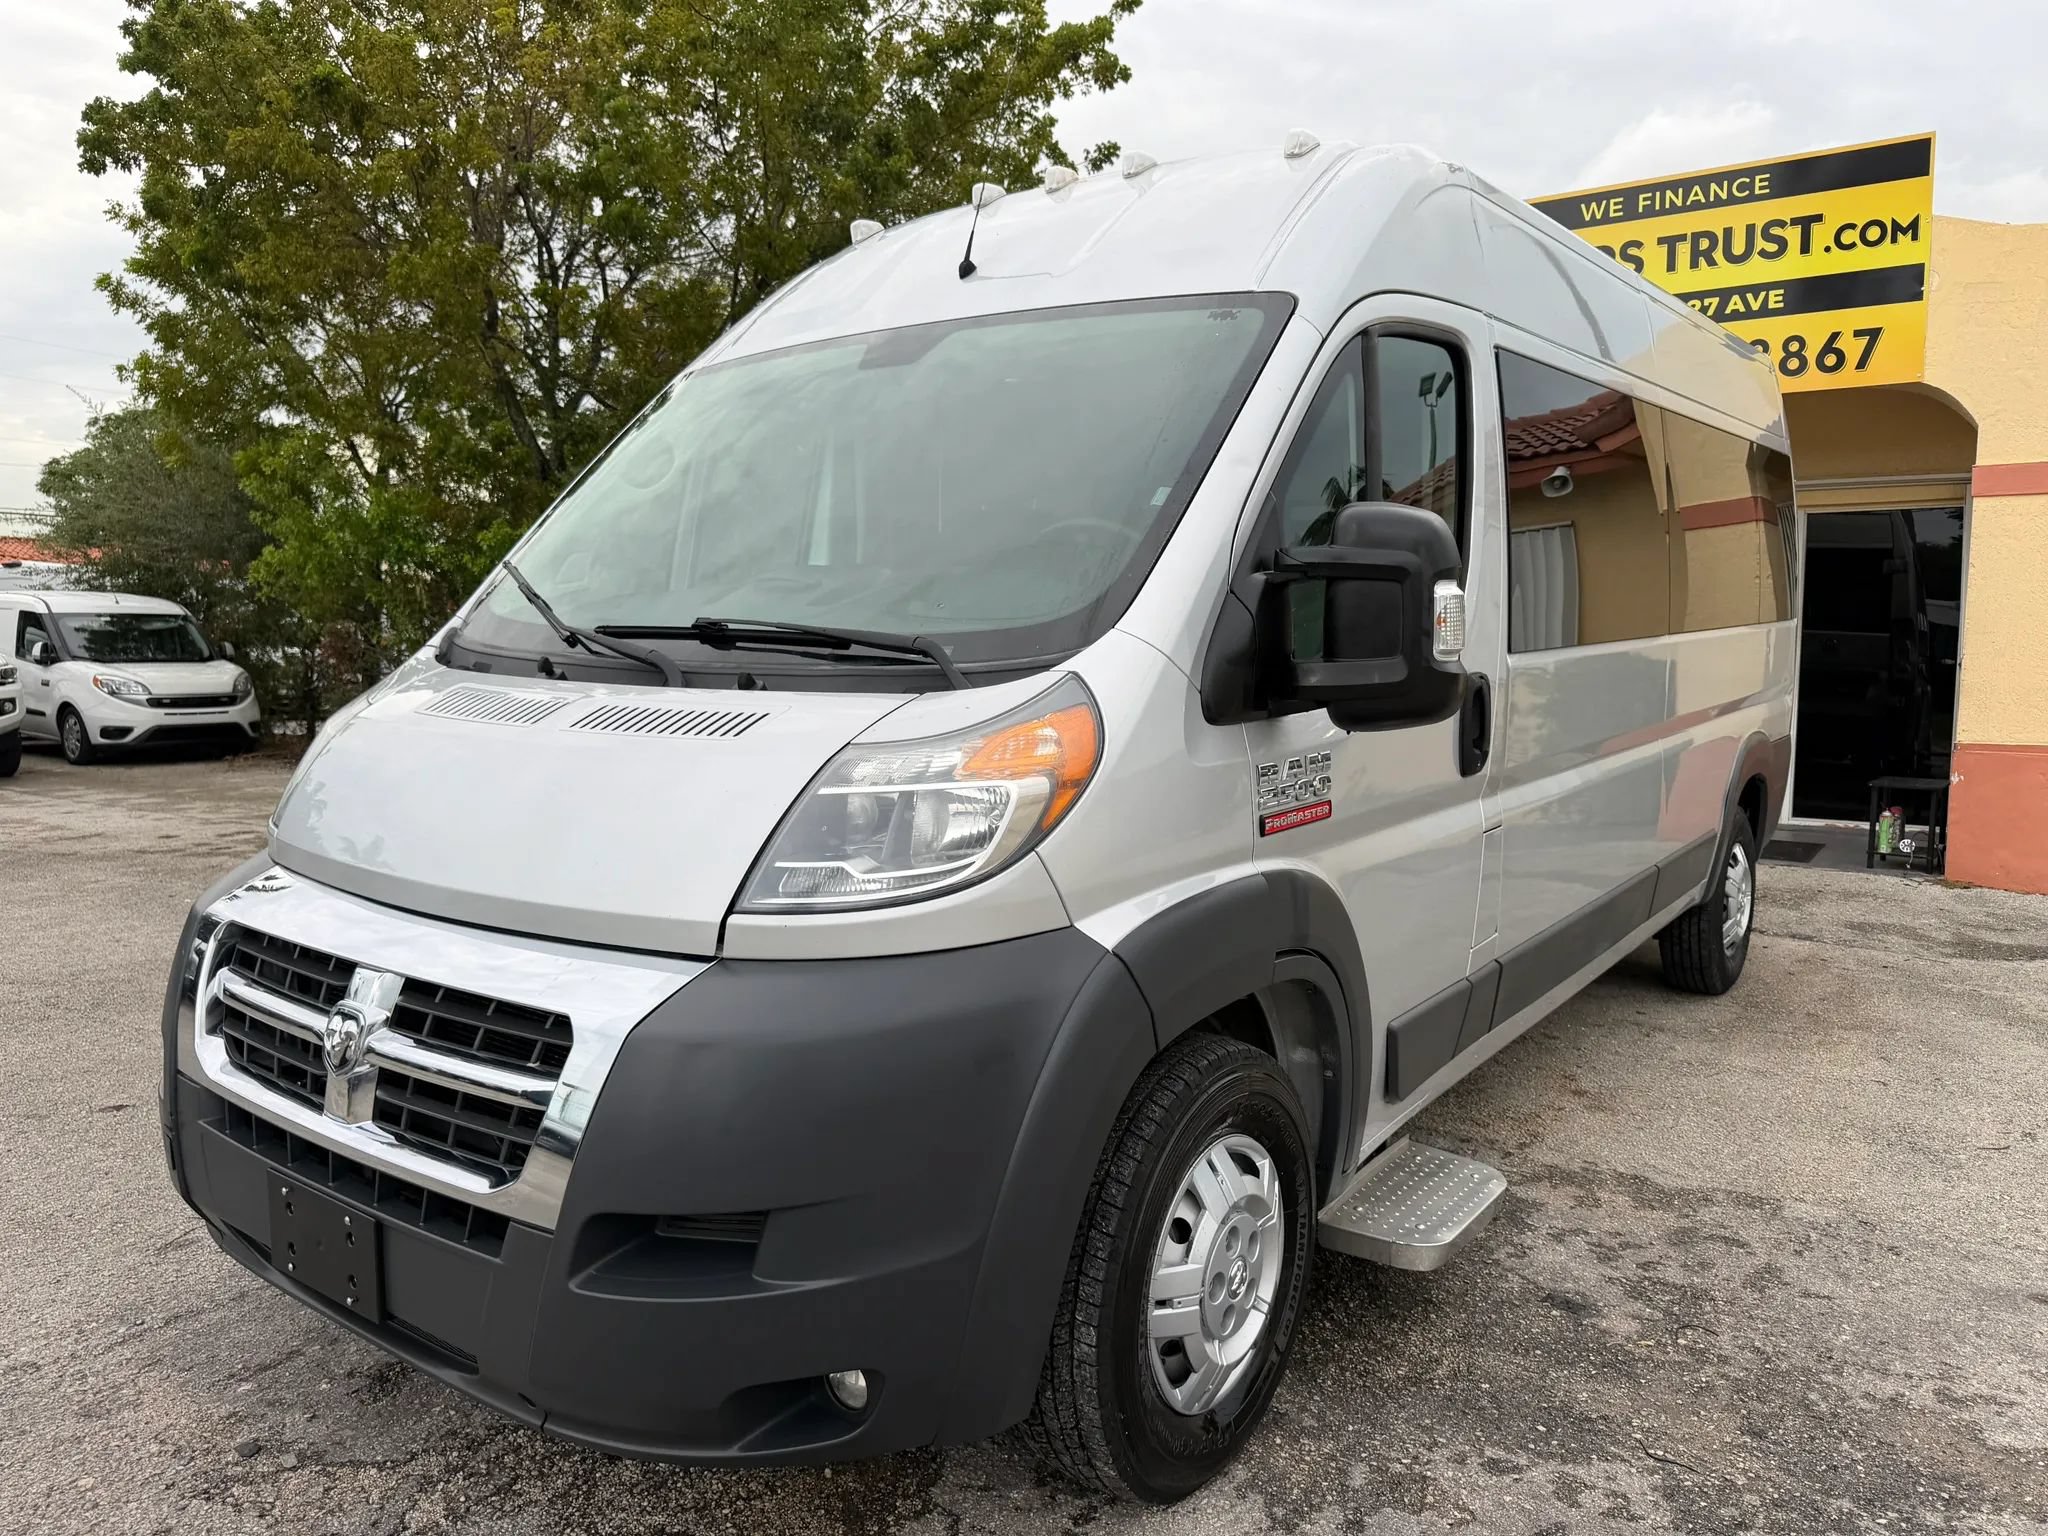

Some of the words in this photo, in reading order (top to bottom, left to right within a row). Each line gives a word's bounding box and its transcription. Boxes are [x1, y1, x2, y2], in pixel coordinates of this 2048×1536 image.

[1580, 198, 1624, 221] WE
[1637, 173, 1771, 214] FINANCE
[1593, 239, 1645, 276] S
[1656, 213, 1920, 275] TRUST.COM
[1724, 289, 1785, 314] AVE
[1256, 750, 1332, 786] RAM
[1265, 804, 1330, 832] PROMASTER
